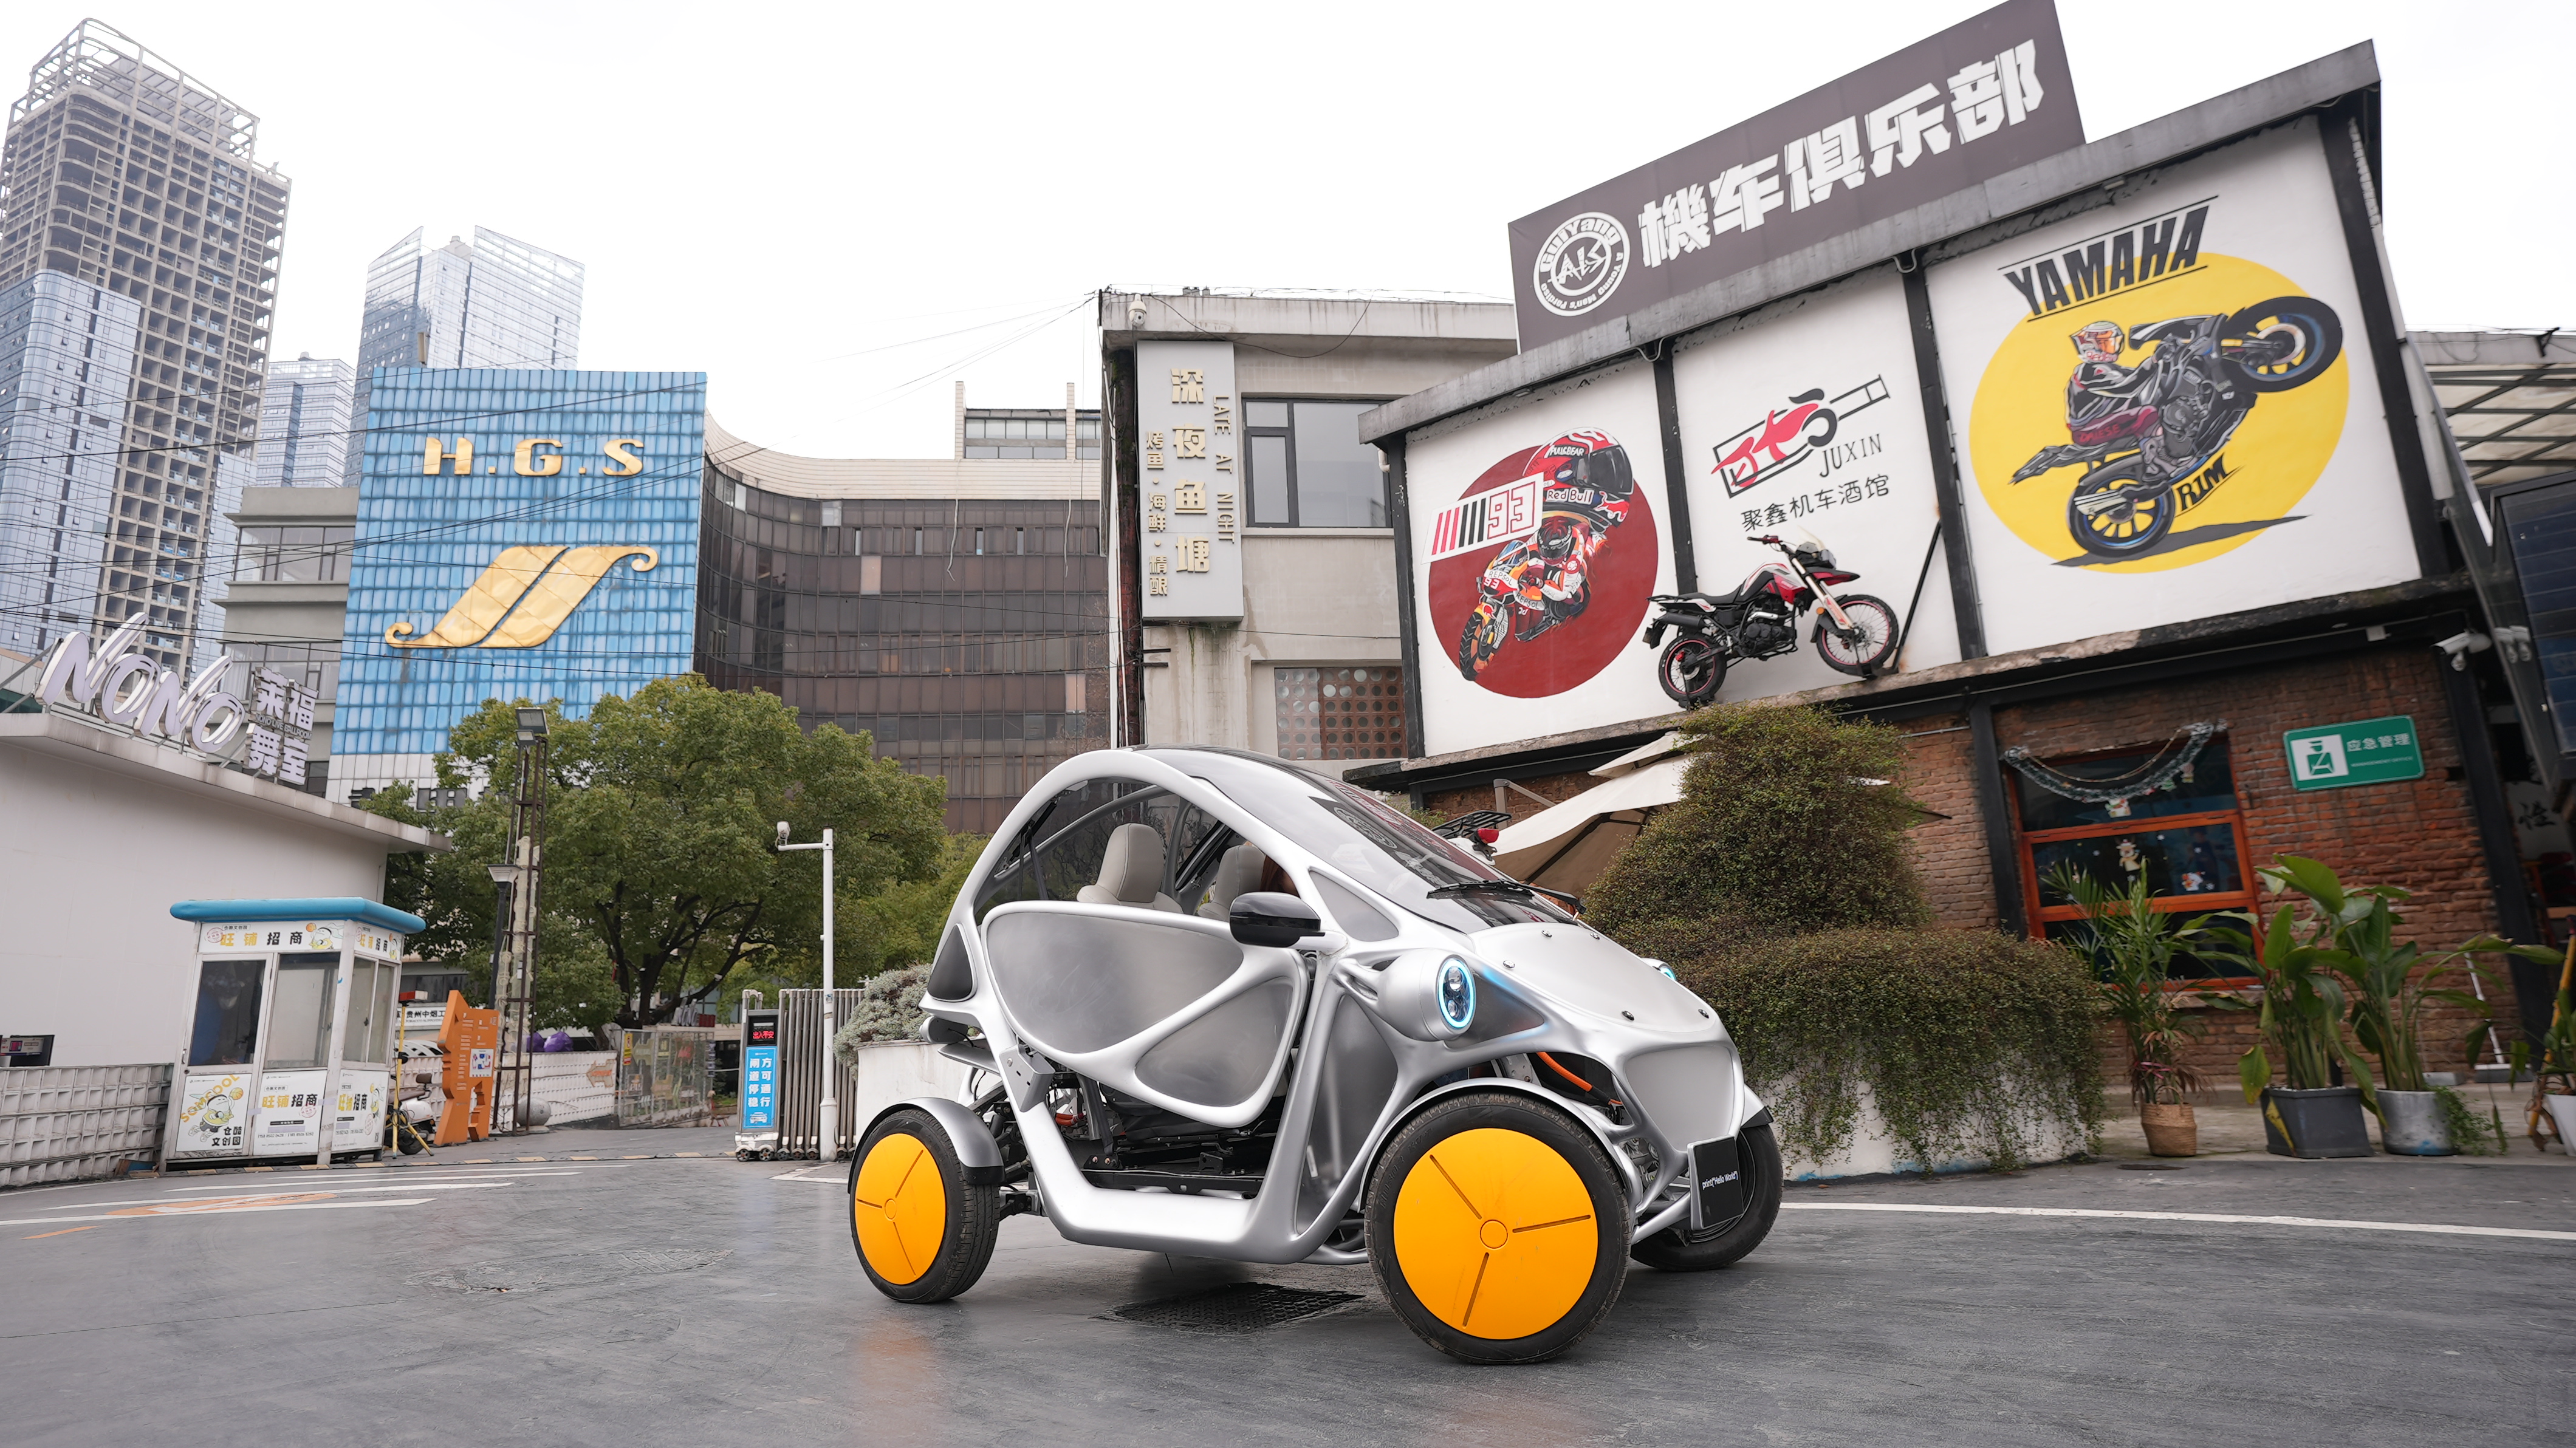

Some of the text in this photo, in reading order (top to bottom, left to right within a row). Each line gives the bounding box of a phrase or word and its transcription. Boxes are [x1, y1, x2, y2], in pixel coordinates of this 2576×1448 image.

[1637, 38, 2044, 268] 機车俱乐部
[2003, 205, 2209, 316] YAMAHA
[1170, 367, 1210, 573] 深夜鱼塘
[1213, 395, 1235, 543] LATE AT NIGHT
[1818, 434, 1883, 478] JUXIN
[1487, 481, 1536, 539] 93
[1547, 490, 1593, 504] Red Bull
[1740, 474, 1889, 532] 聚鑫机车酒馆
[1484, 578, 1500, 590] 93
[1488, 570, 1513, 586] REPSOL
[1515, 591, 1540, 610] REPSOL
[253, 666, 319, 731] 莱福
[247, 723, 309, 785] 舞室
[2346, 732, 2411, 753] 应急管理
[220, 931, 303, 947] 旺铺招商
[752, 1031, 775, 1039] 出入平安
[760, 1057, 773, 1107] 方可通行
[262, 1093, 318, 1108] 旺铺招商
[211, 1136, 241, 1147] 文创园
[224, 1126, 242, 1136] 仓酷
